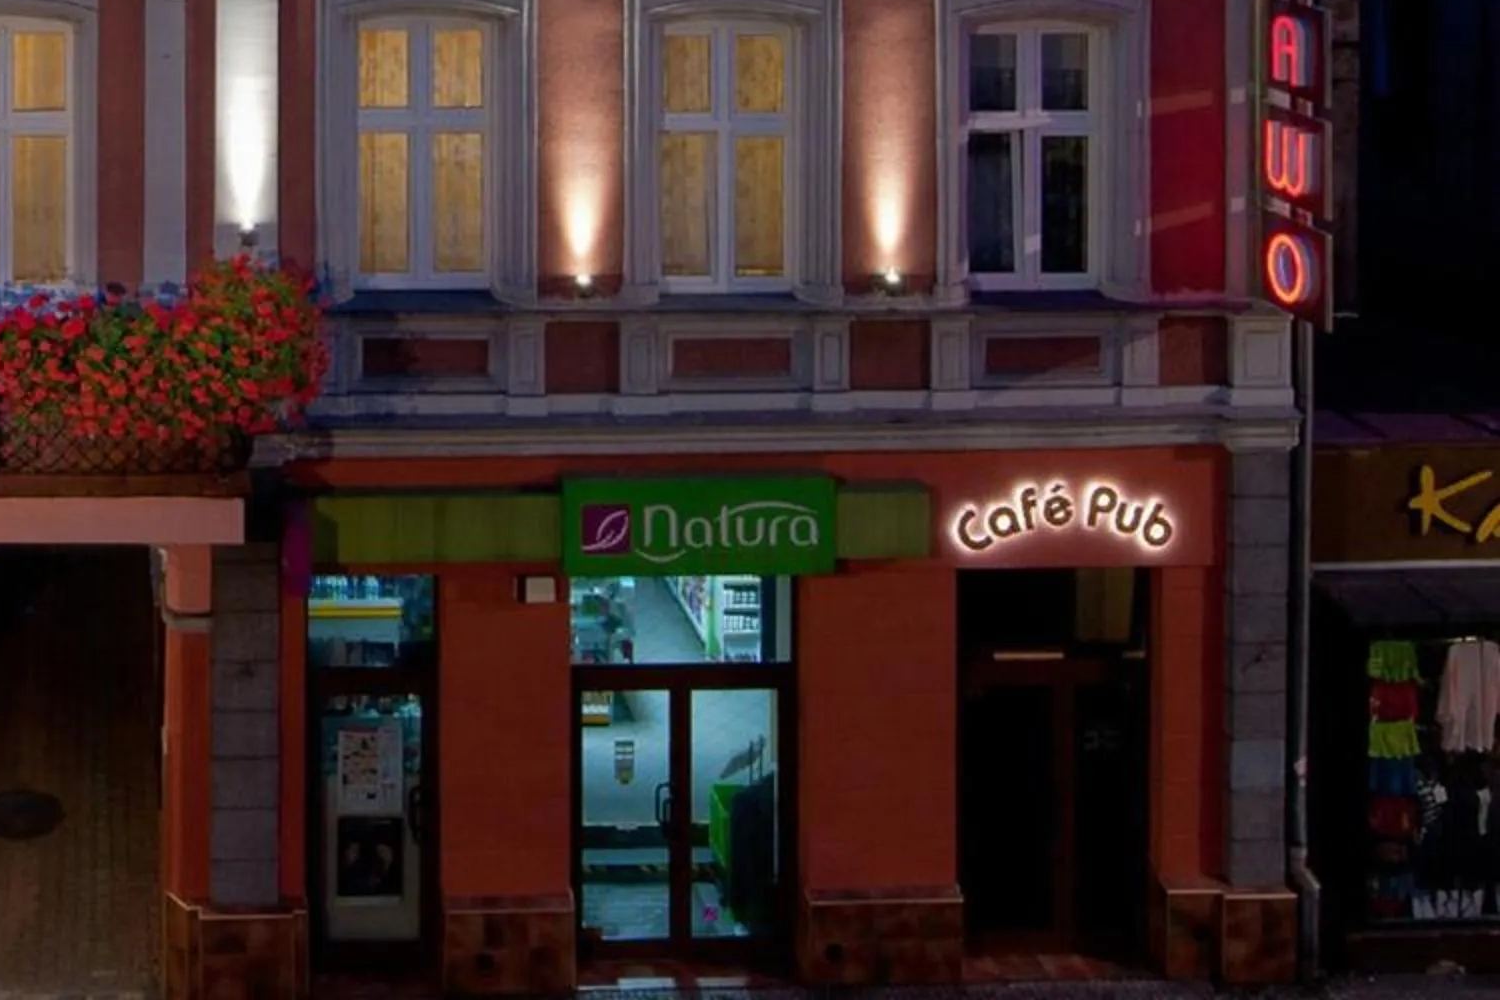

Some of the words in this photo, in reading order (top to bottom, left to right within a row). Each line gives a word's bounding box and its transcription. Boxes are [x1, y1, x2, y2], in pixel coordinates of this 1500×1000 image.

[1265, 15, 1306, 304] AWO
[643, 501, 819, 549] Natura
[957, 483, 1073, 551] Café
[1087, 486, 1173, 546] Pub
